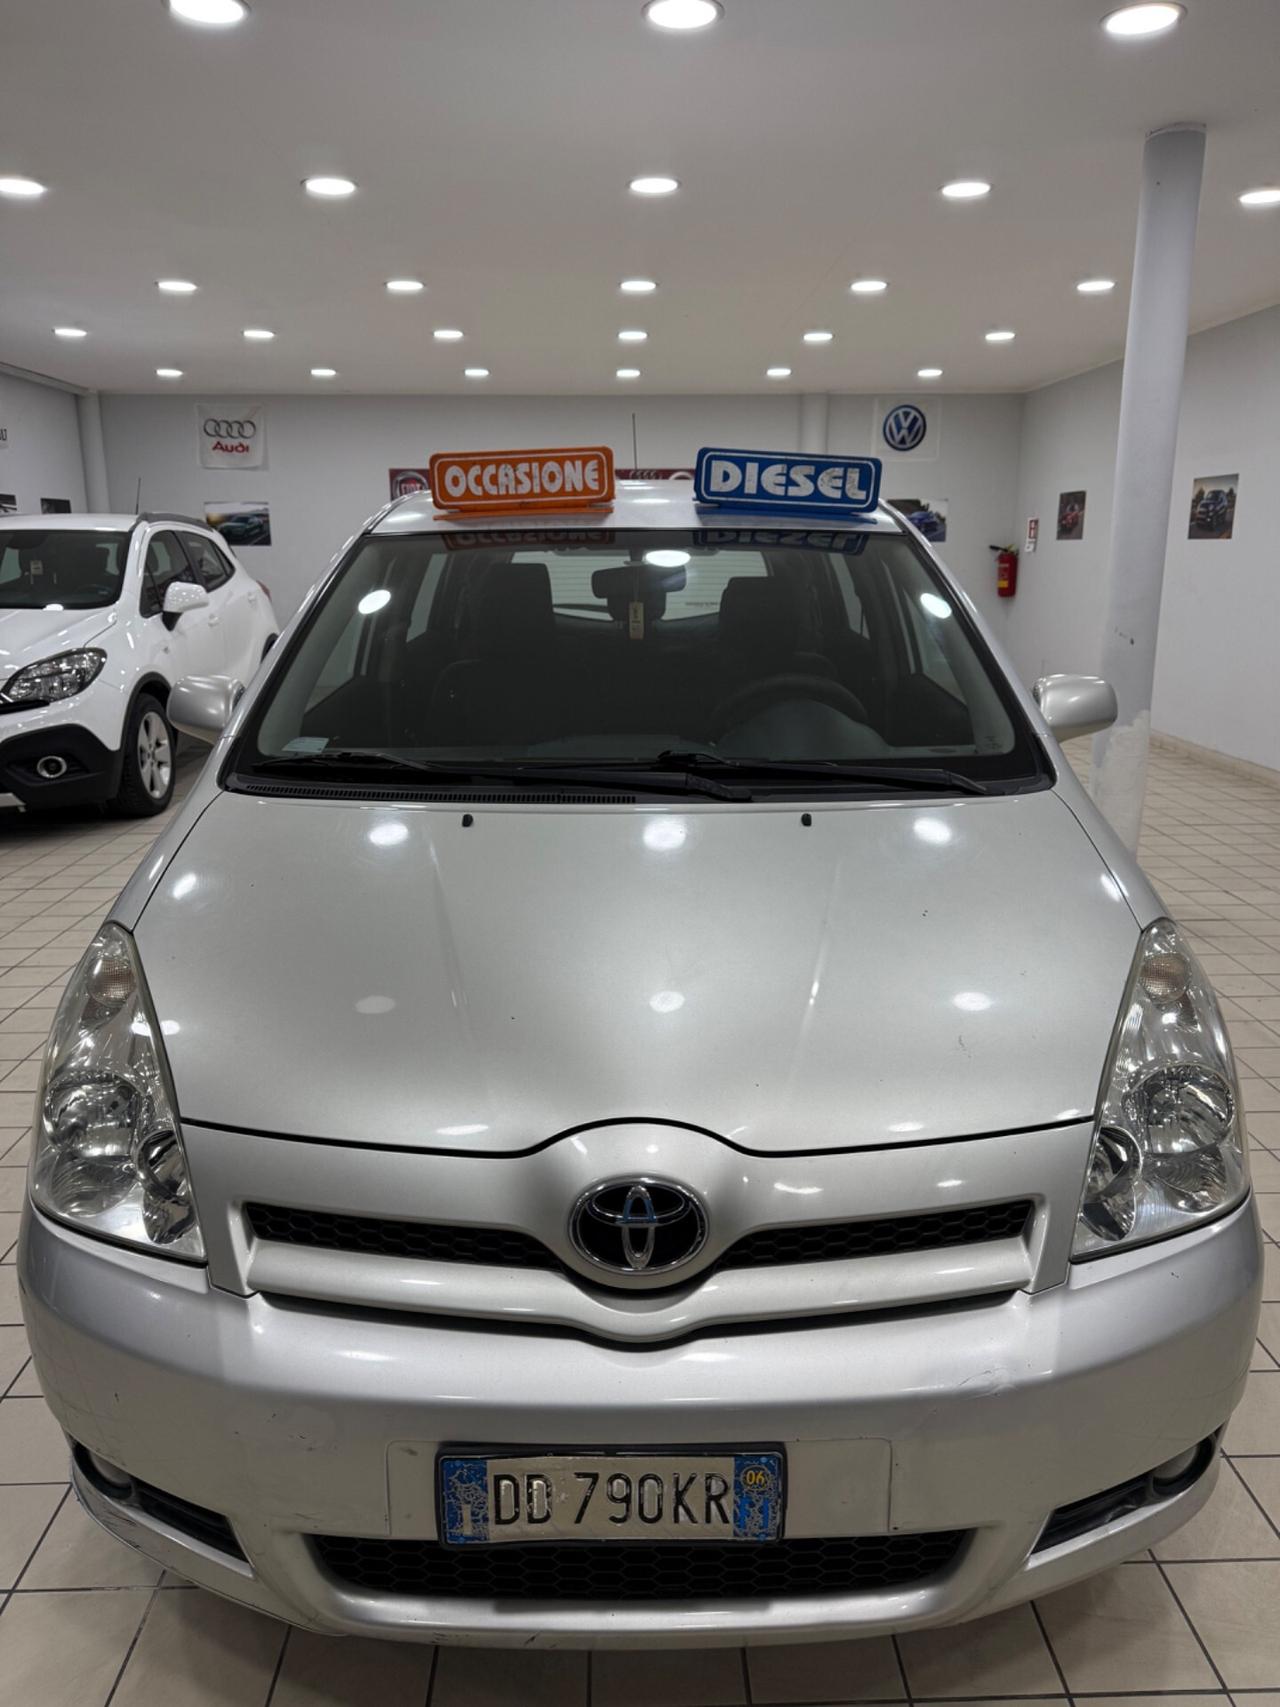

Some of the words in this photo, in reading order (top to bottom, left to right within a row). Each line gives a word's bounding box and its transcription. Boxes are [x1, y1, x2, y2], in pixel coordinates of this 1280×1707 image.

[212, 440, 250, 453] Audi
[445, 459, 600, 498] OCCASIONE
[709, 459, 867, 500] DIESEL
[745, 1469, 766, 1486] 06
[494, 1472, 553, 1526] DD
[573, 1471, 731, 1526] 790KR
